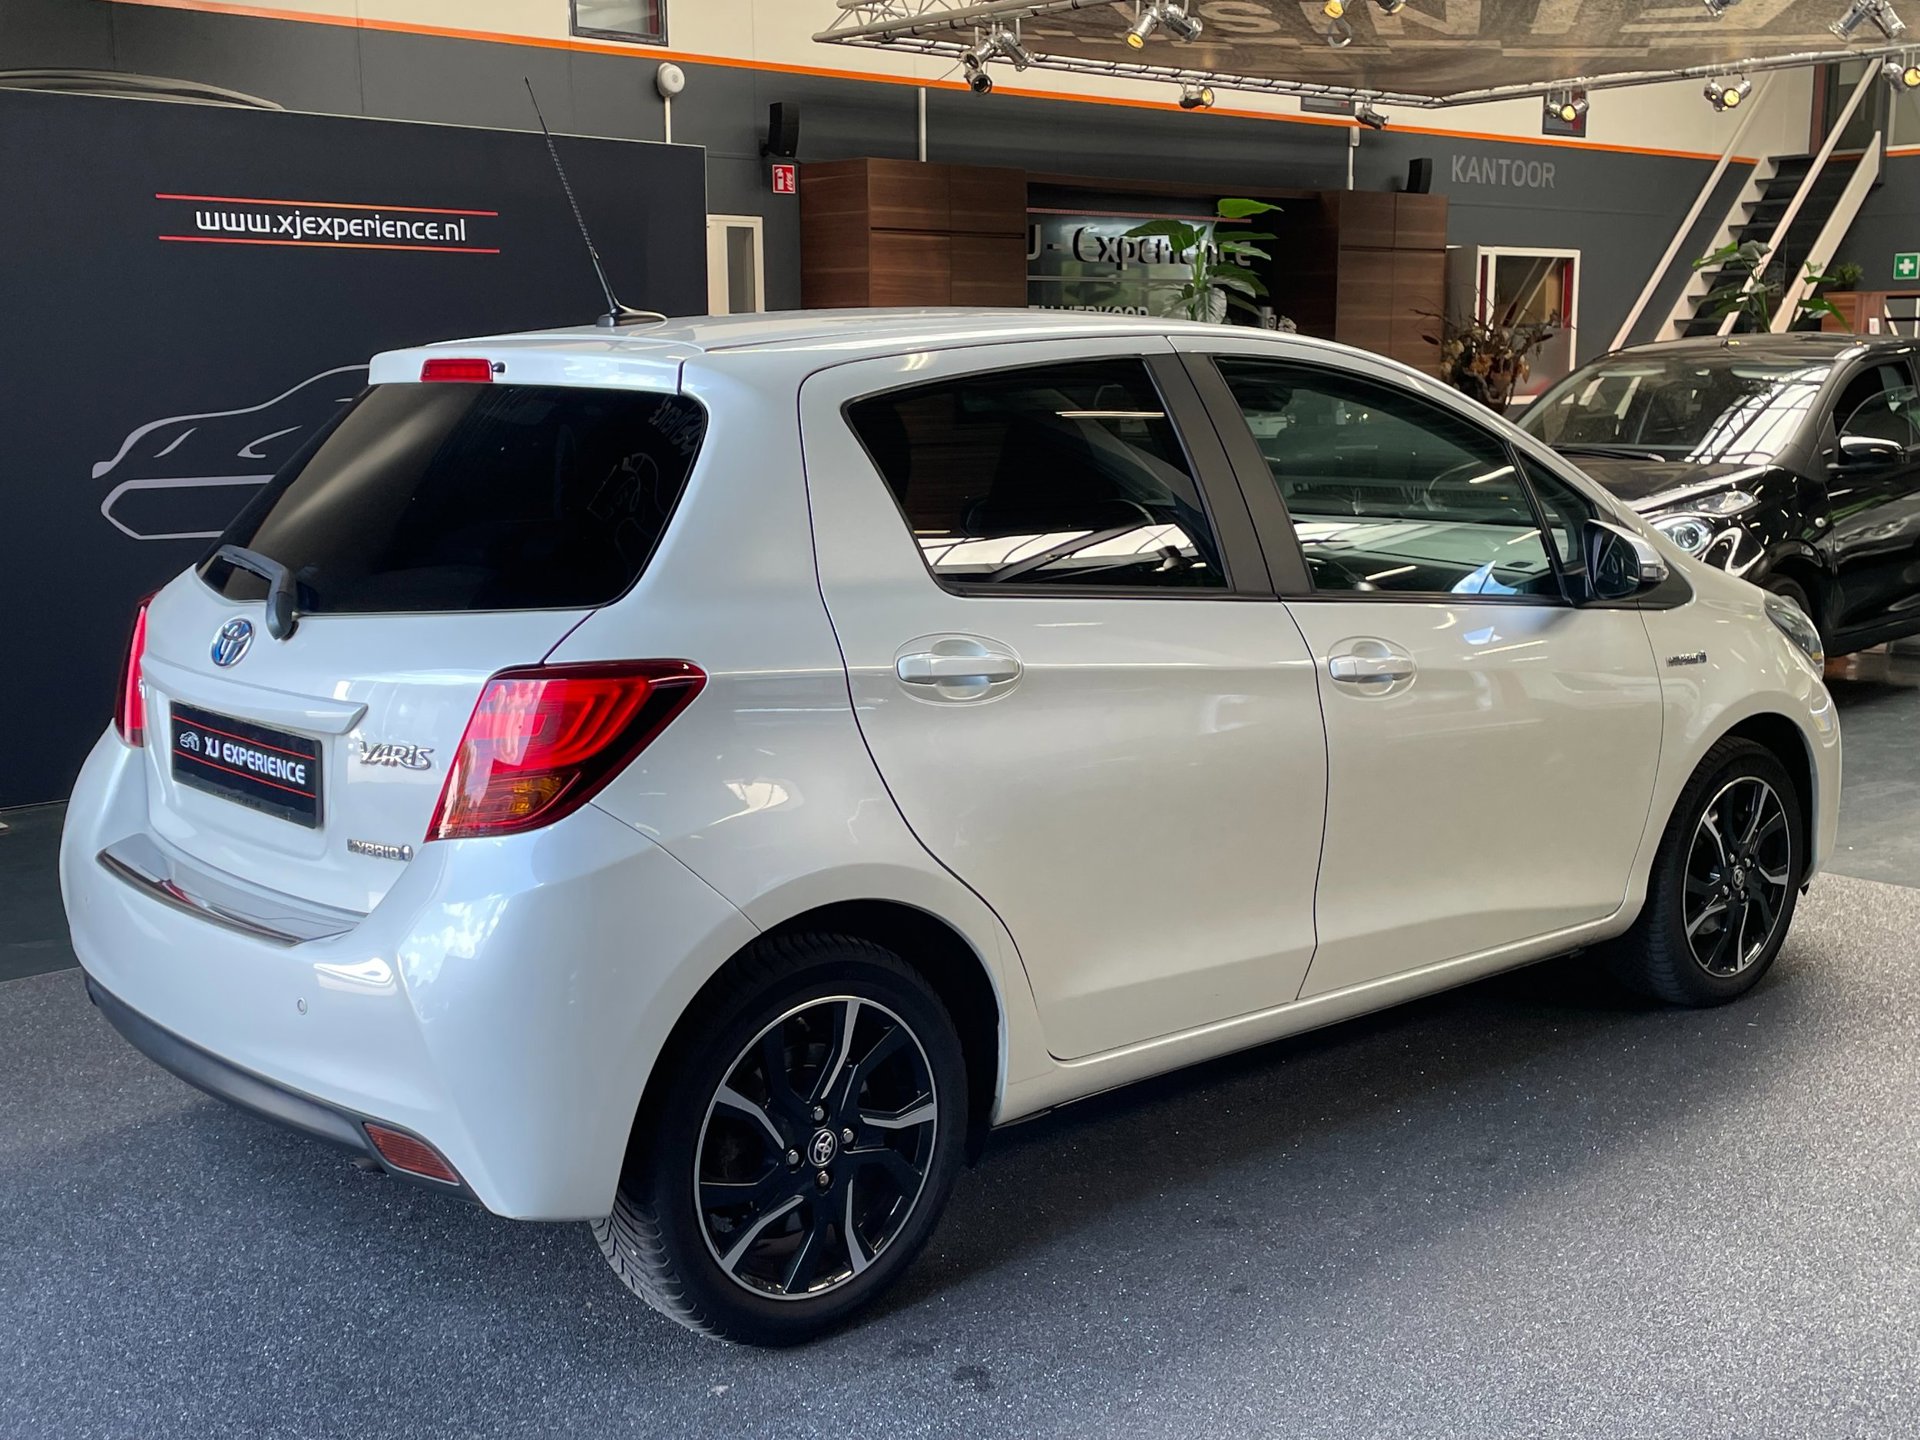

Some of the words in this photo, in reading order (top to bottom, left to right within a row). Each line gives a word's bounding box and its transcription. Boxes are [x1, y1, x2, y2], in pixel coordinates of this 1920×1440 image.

[1105, 0, 1798, 35] FINIS
[1452, 155, 1555, 188] KANTOOR
[195, 210, 467, 241] www.xjexperience.nl
[204, 736, 219, 758] XJ
[223, 743, 305, 784] EXPERIENCE
[359, 741, 435, 771] YARIS
